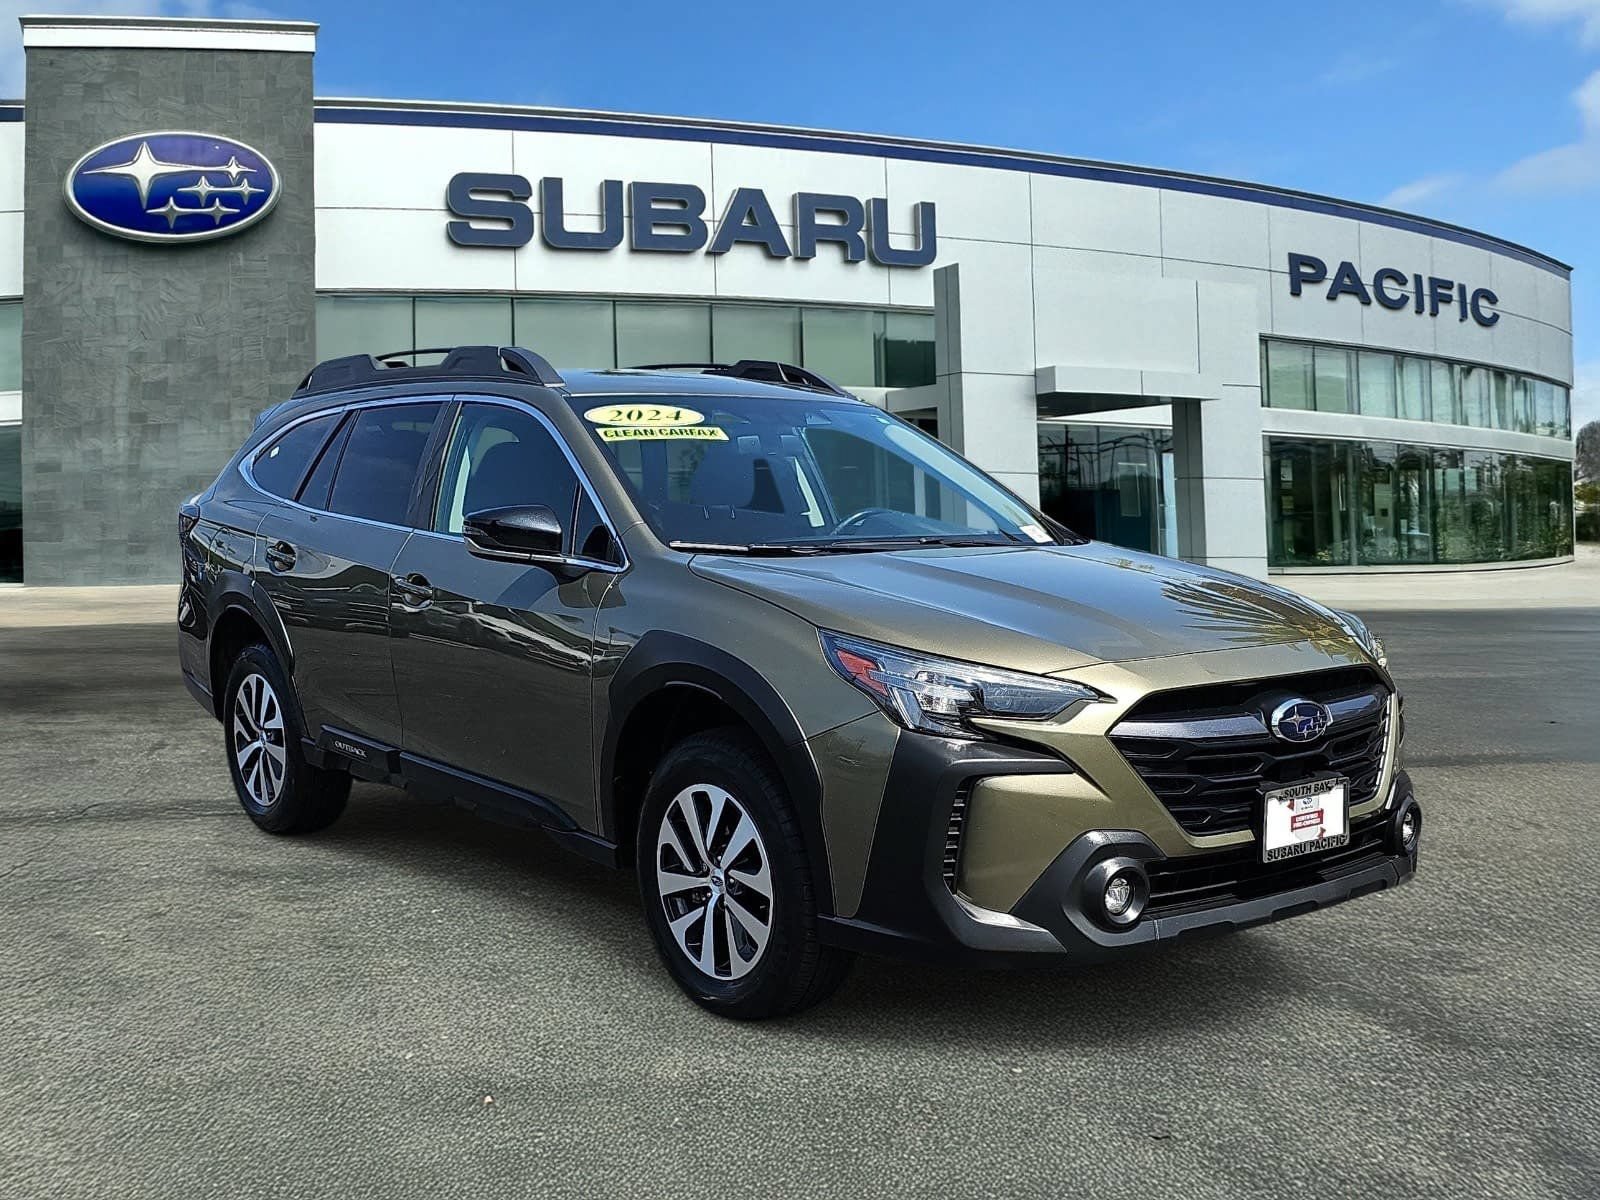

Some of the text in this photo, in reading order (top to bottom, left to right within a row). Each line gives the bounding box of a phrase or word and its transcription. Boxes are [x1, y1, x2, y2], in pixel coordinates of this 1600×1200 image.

[447, 172, 937, 266] SUBARU
[1288, 252, 1500, 327] PACIFIC
[608, 409, 683, 422] 2024
[603, 427, 719, 438] CLEAN CARFAX
[334, 740, 367, 757] OUTBACK
[1284, 780, 1331, 798] SOUTH BAY
[1267, 834, 1347, 861] SUBARU PACIFIC
